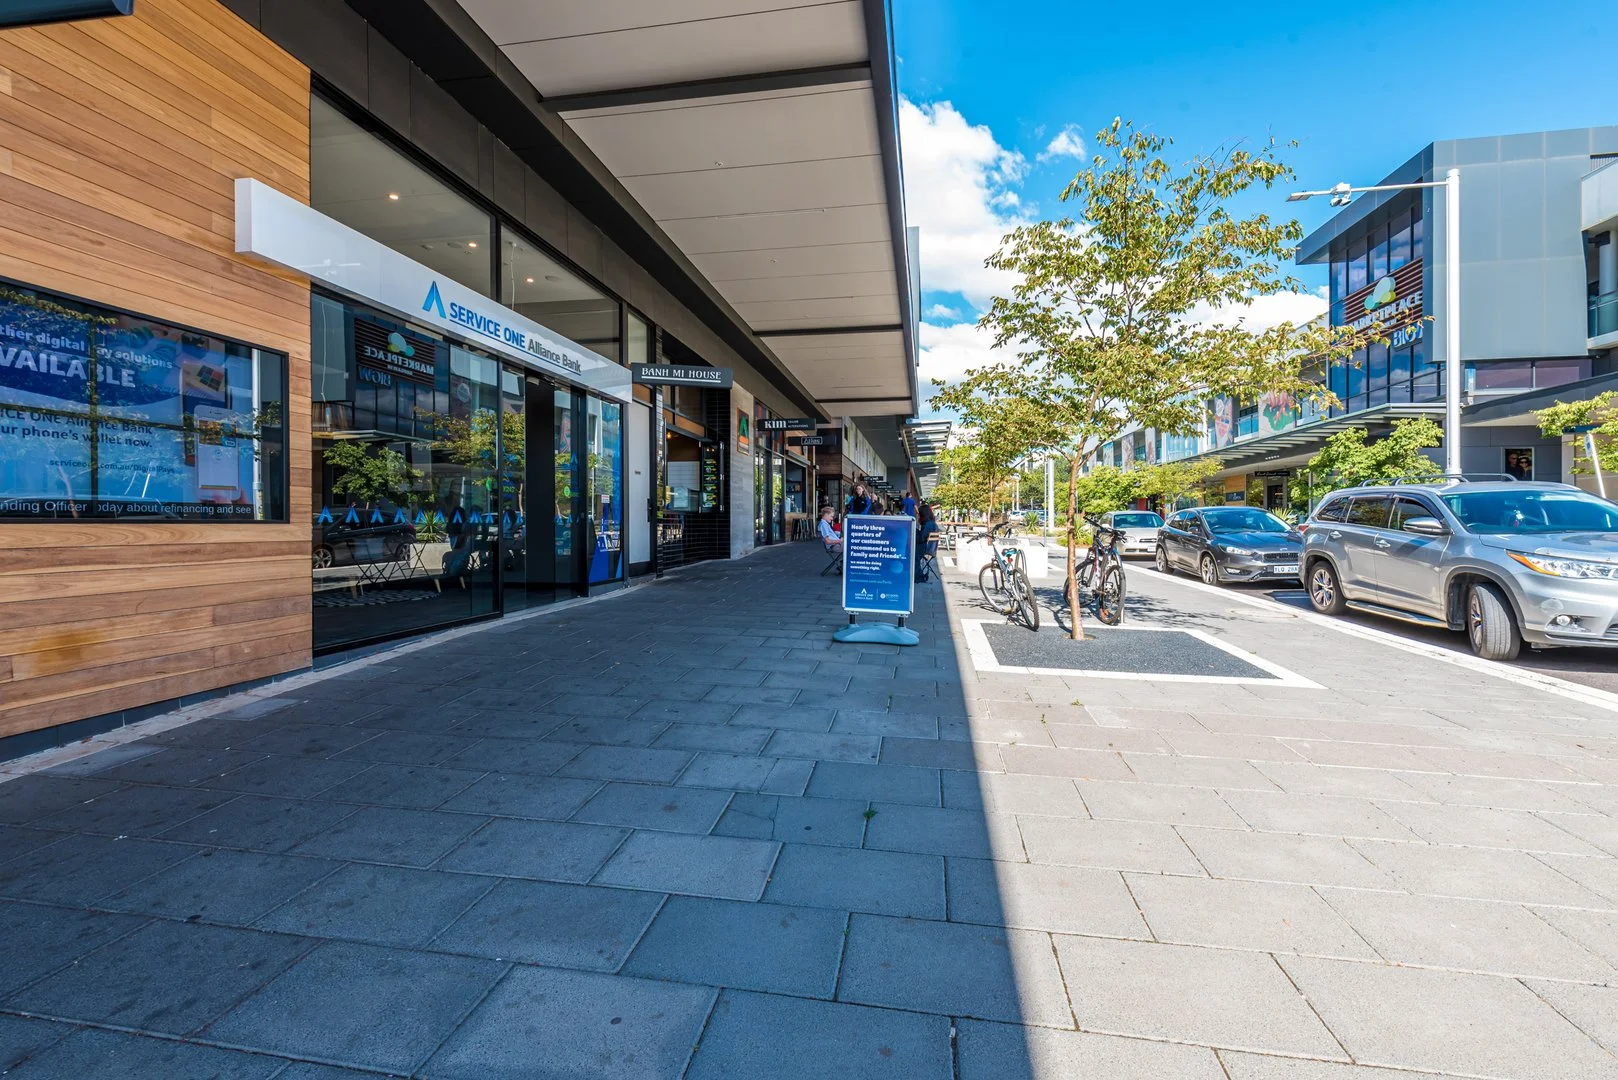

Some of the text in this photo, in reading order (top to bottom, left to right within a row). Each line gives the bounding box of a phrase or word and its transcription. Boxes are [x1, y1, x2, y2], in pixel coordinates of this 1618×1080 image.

[1347, 290, 1423, 331] ARKETPLACE
[449, 302, 582, 373] SERVICE ONE Alliance Bank
[36, 332, 86, 352] digital
[115, 349, 173, 369] solutions
[641, 367, 722, 380] BANH MI HOUSE
[22, 425, 79, 441] phone's
[124, 438, 153, 448] now.
[123, 420, 153, 435] Bank
[44, 500, 87, 512] Officer
[126, 502, 159, 513] about
[160, 503, 215, 516] refinancing
[216, 505, 234, 514] and
[235, 506, 251, 514] see
